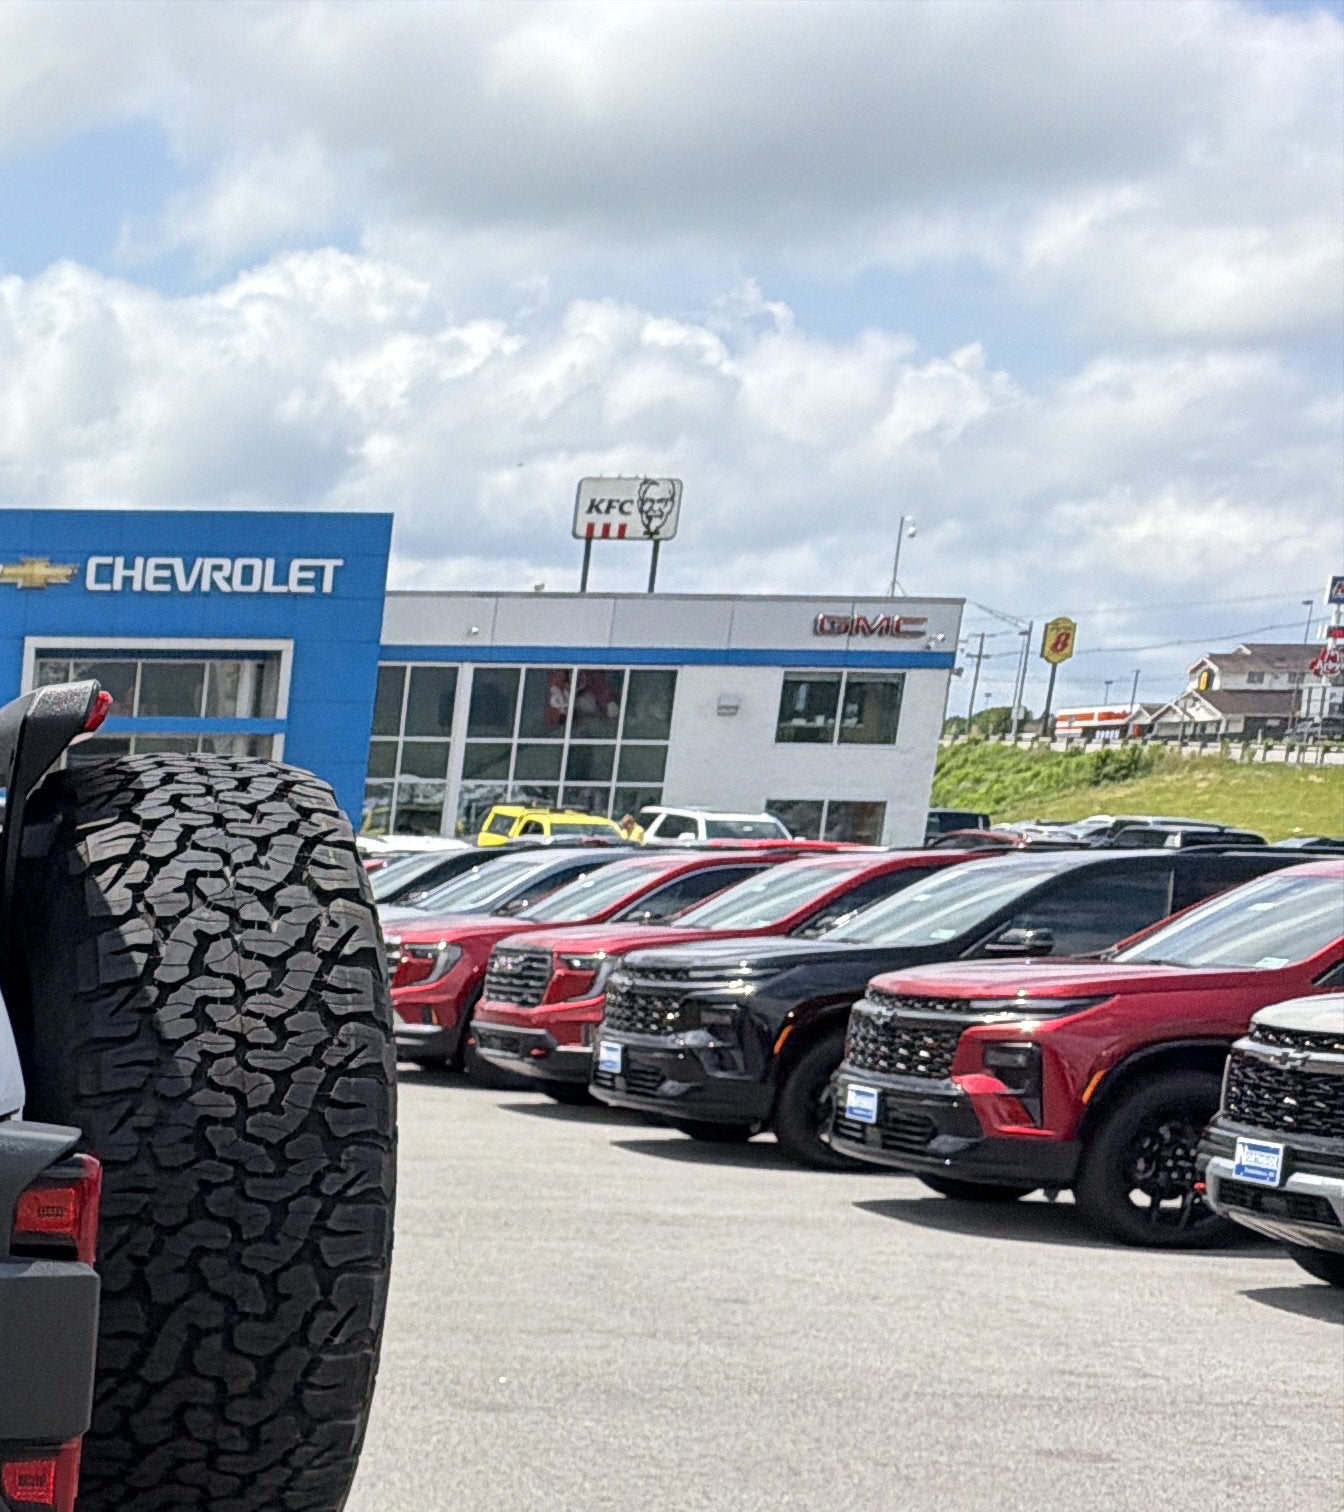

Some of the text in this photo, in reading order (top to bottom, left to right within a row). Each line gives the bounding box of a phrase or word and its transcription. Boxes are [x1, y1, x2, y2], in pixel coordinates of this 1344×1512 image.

[585, 497, 635, 516] KFC
[85, 555, 345, 594] CHEVROLET
[813, 613, 929, 638] GMC
